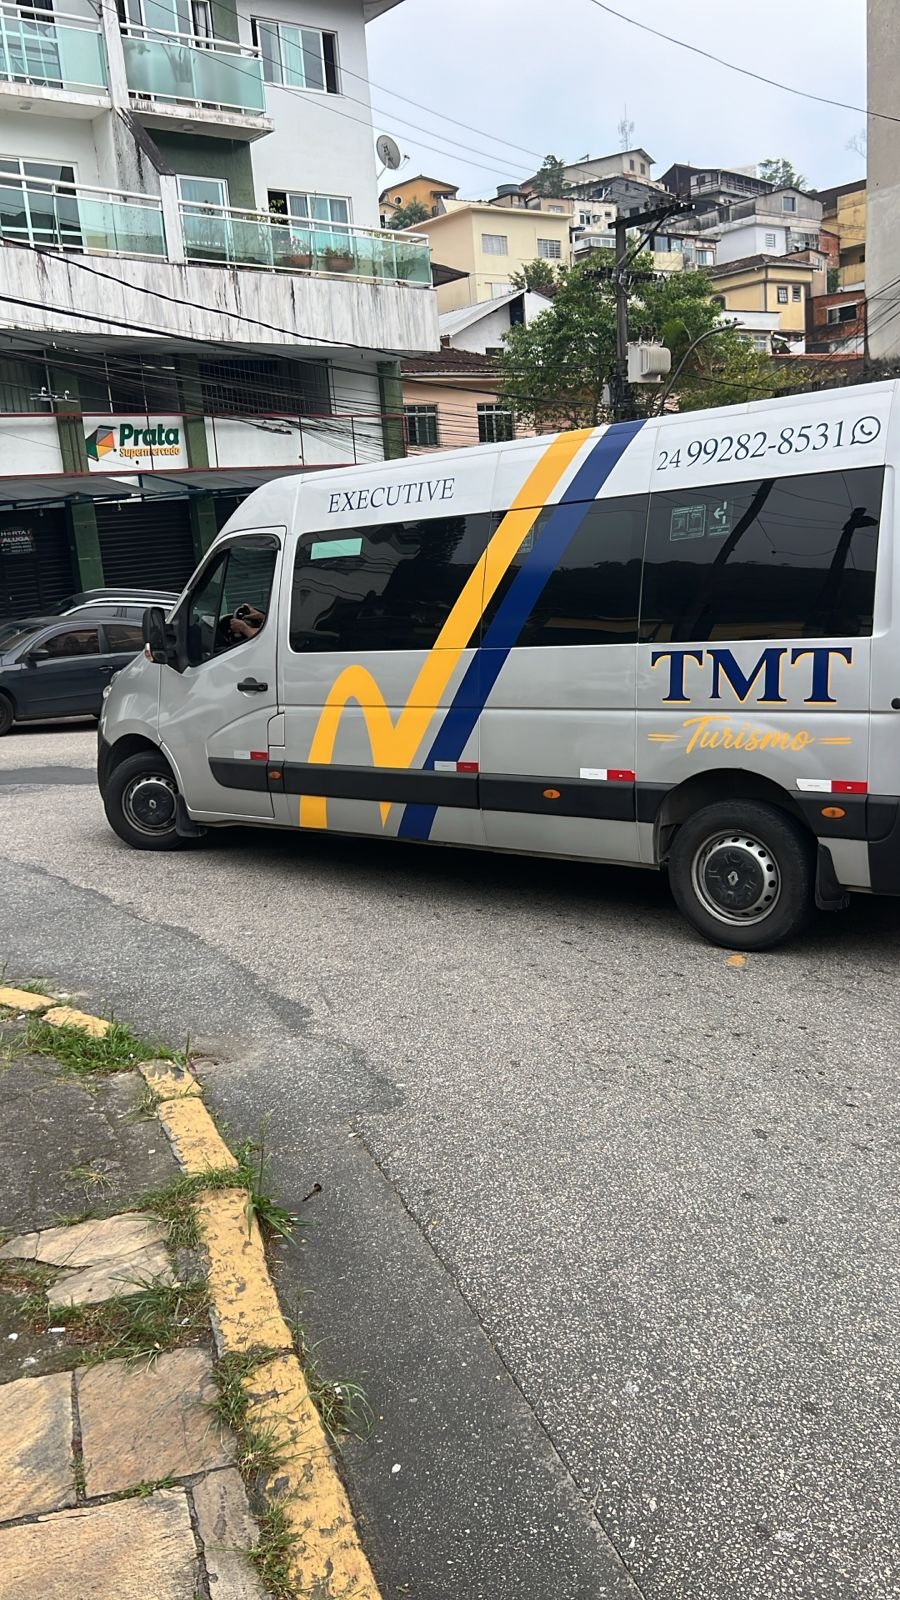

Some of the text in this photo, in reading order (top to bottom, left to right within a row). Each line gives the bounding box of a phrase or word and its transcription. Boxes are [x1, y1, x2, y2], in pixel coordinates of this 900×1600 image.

[119, 423, 179, 447] Prata
[119, 446, 180, 459] Supermercado
[656, 420, 843, 471] 24 99282-8531
[327, 478, 455, 513] EXECUTIVE
[651, 647, 852, 704] TMT
[682, 715, 815, 754] Turismo
